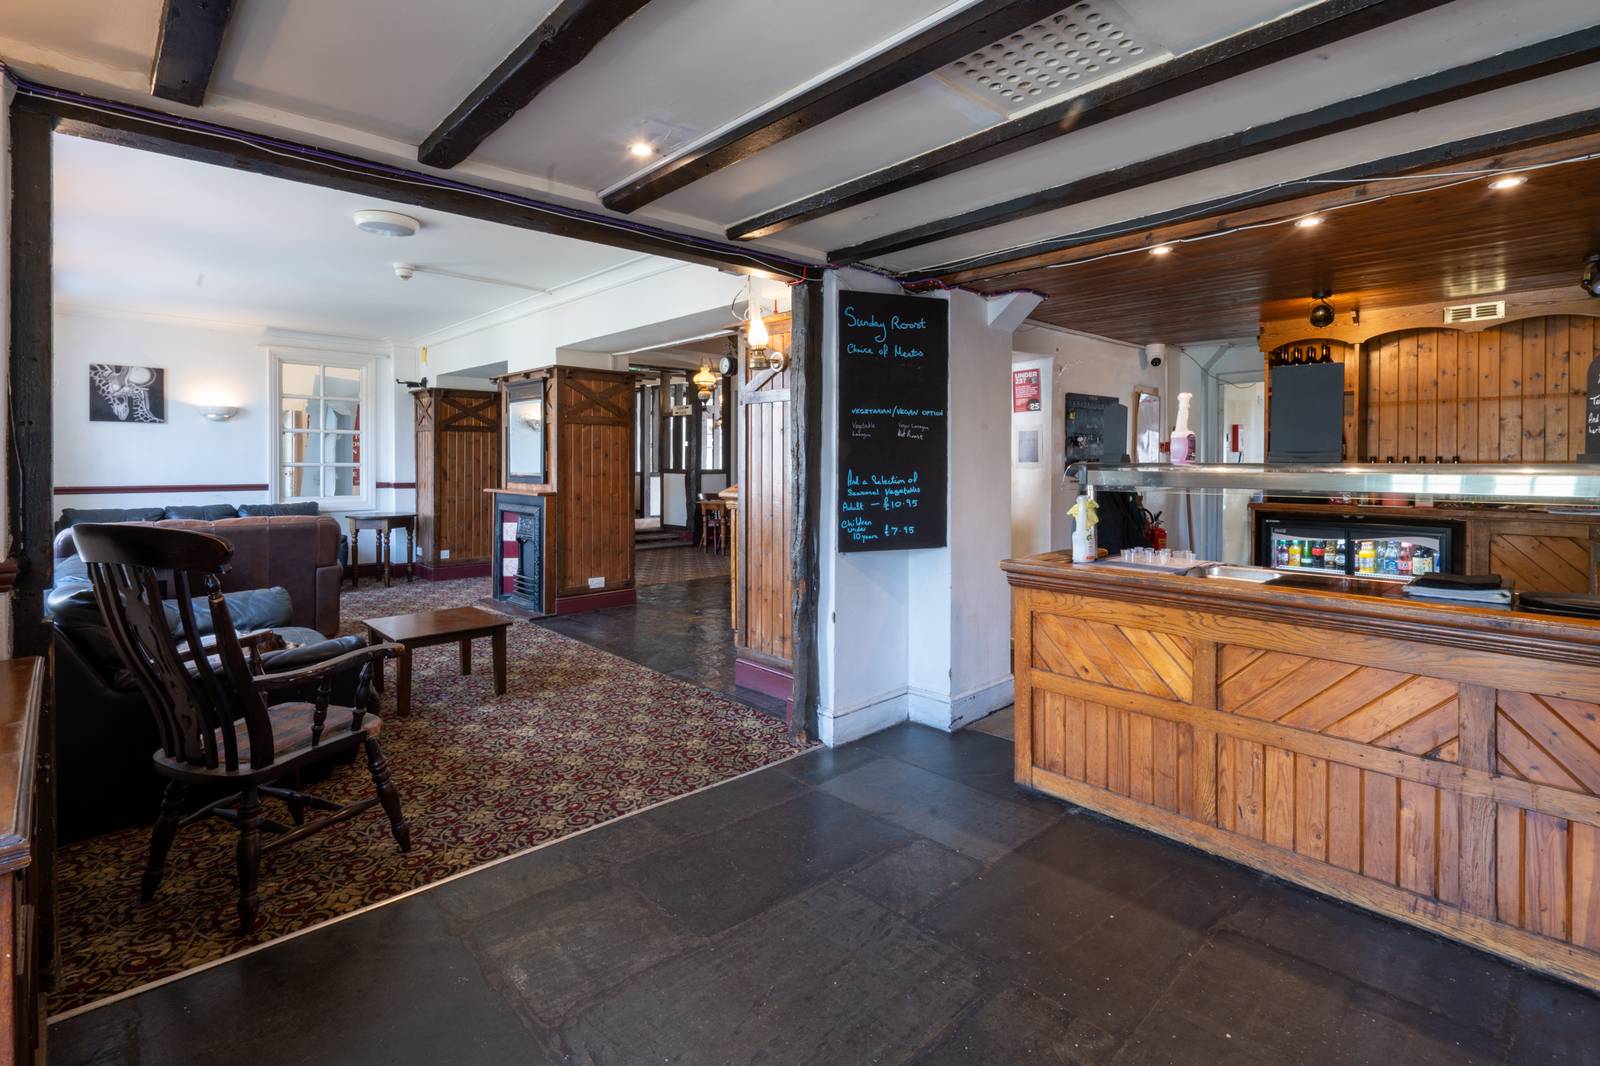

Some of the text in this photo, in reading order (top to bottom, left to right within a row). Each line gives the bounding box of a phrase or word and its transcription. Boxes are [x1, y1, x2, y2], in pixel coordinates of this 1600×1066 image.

[844, 306, 927, 343] Sunday Roast
[847, 343, 874, 354] Choice
[878, 343, 889, 358] of
[1030, 402, 1040, 410] 25
[907, 471, 918, 484] of
[847, 488, 879, 497] Seasonal
[842, 501, 864, 512] Adult
[841, 517, 872, 528] Children
[852, 532, 861, 540] 10
